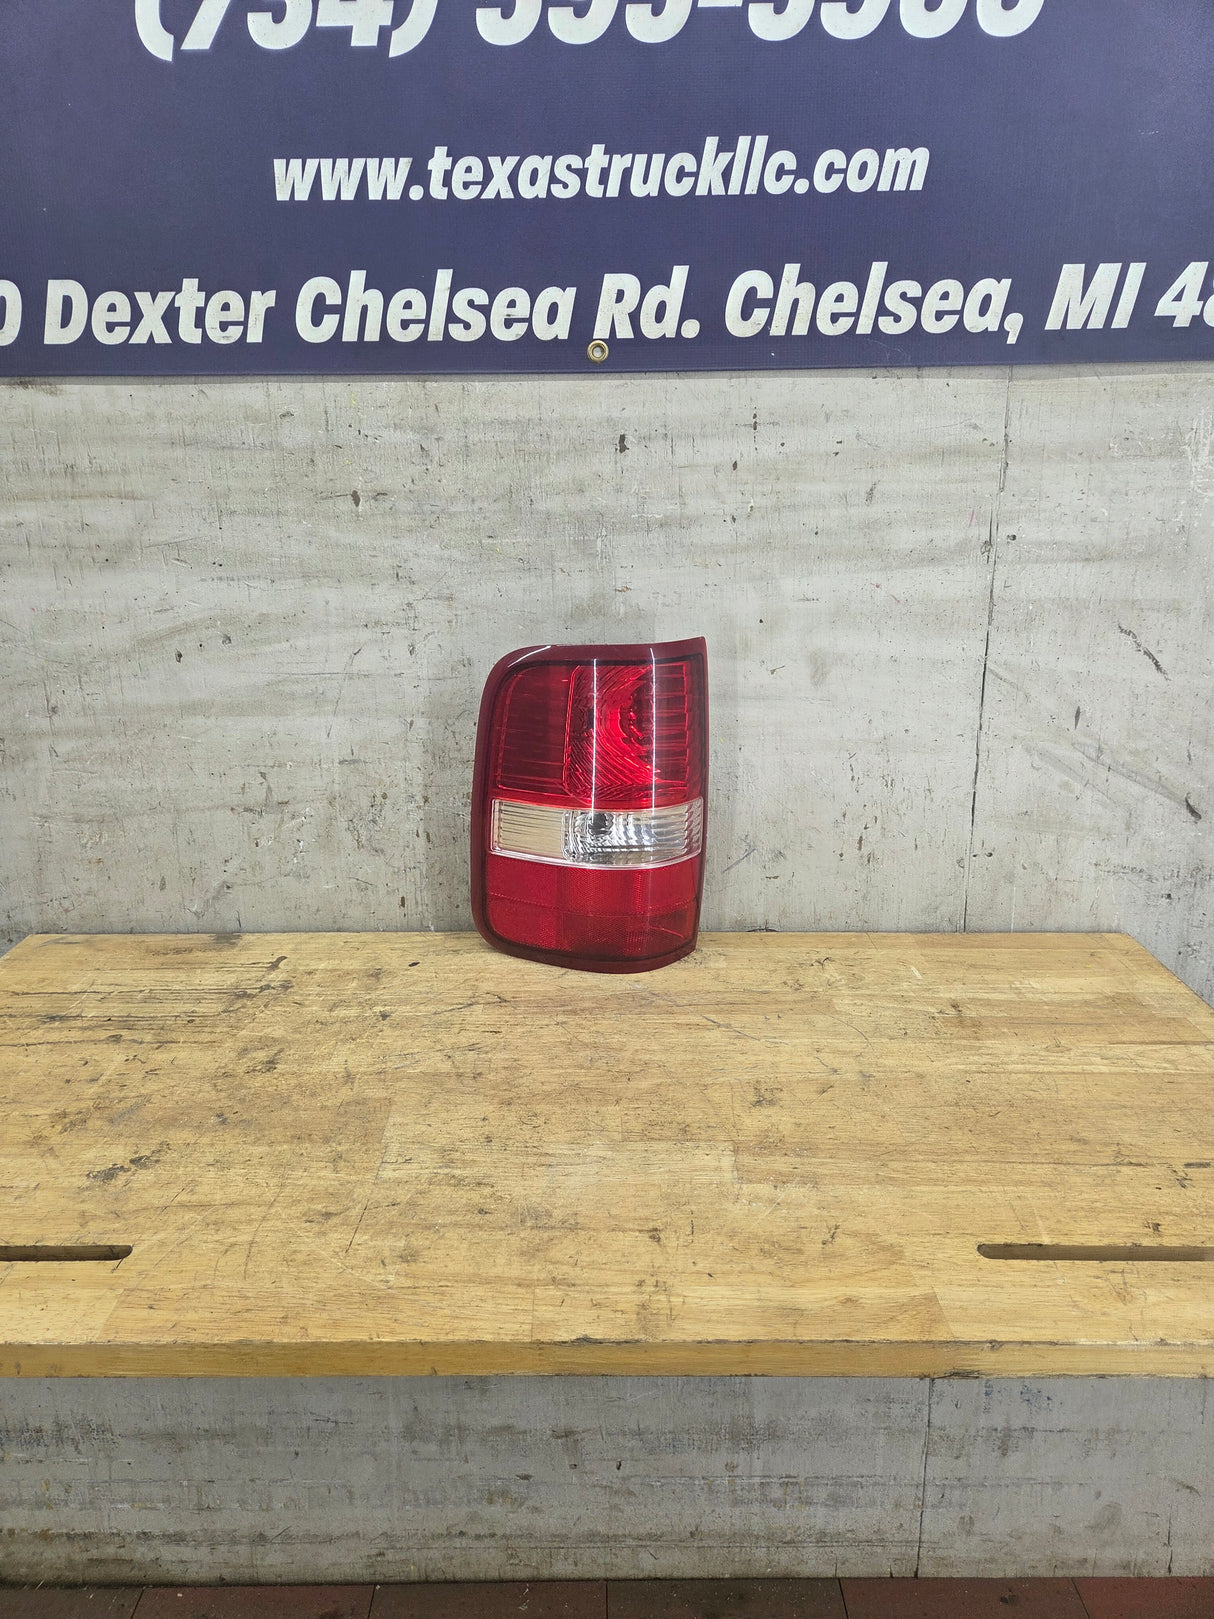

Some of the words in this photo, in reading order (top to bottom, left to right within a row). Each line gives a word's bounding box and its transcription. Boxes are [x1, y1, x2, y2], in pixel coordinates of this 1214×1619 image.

[273, 134, 931, 202] www.texastruckllc.com
[43, 277, 277, 346] Dexter
[295, 268, 577, 344] Chelsea
[592, 264, 701, 341] Rd.
[724, 261, 1024, 345] Chelsea,
[1044, 261, 1148, 331] MI
[1153, 261, 1214, 329] 4
